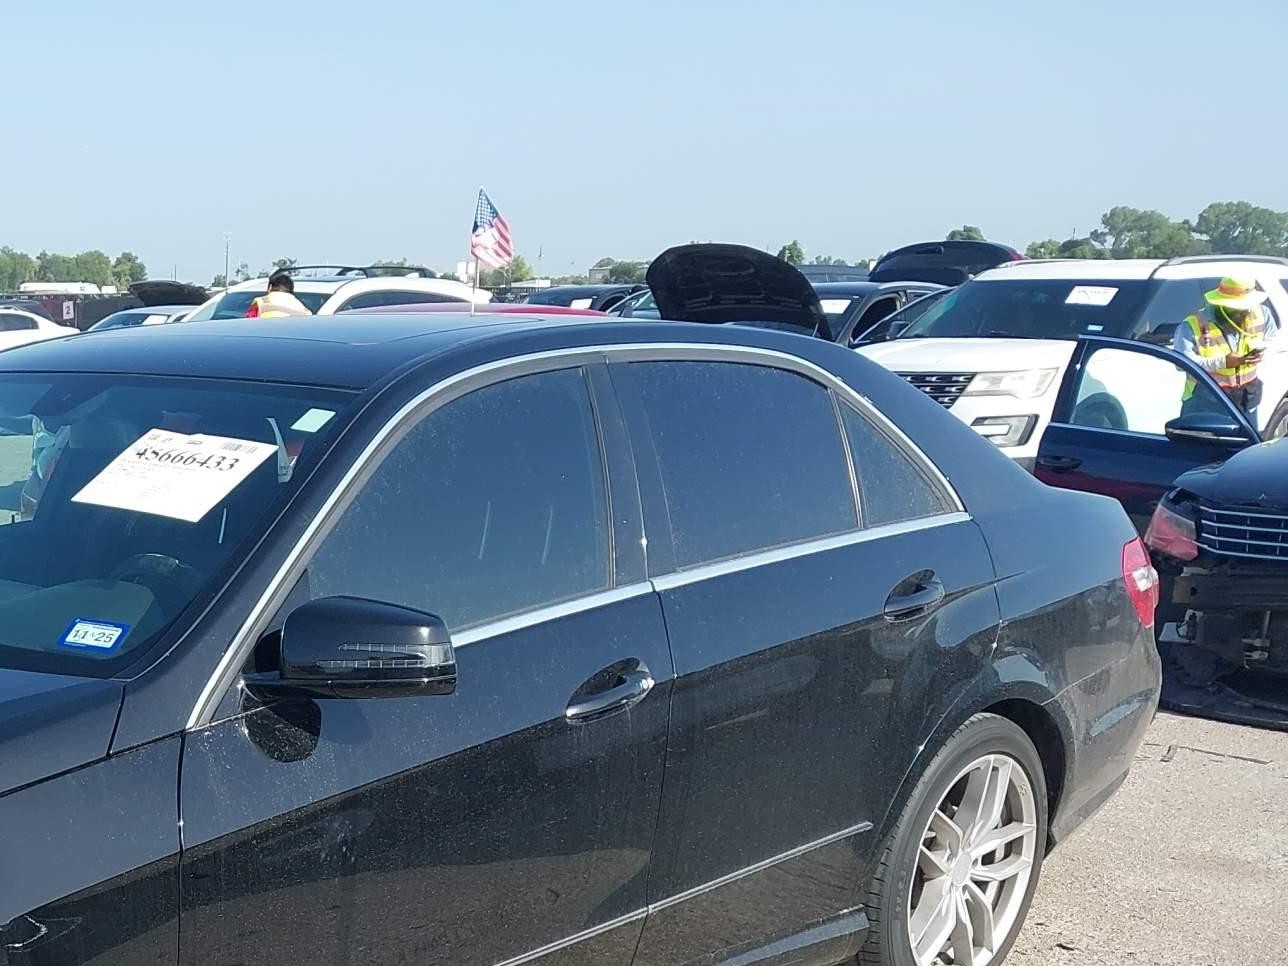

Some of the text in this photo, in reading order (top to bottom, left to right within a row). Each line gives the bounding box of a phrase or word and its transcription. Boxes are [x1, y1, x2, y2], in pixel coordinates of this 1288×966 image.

[65, 305, 71, 315] 2
[135, 446, 240, 471] 45666433
[73, 629, 114, 643] 11 25
